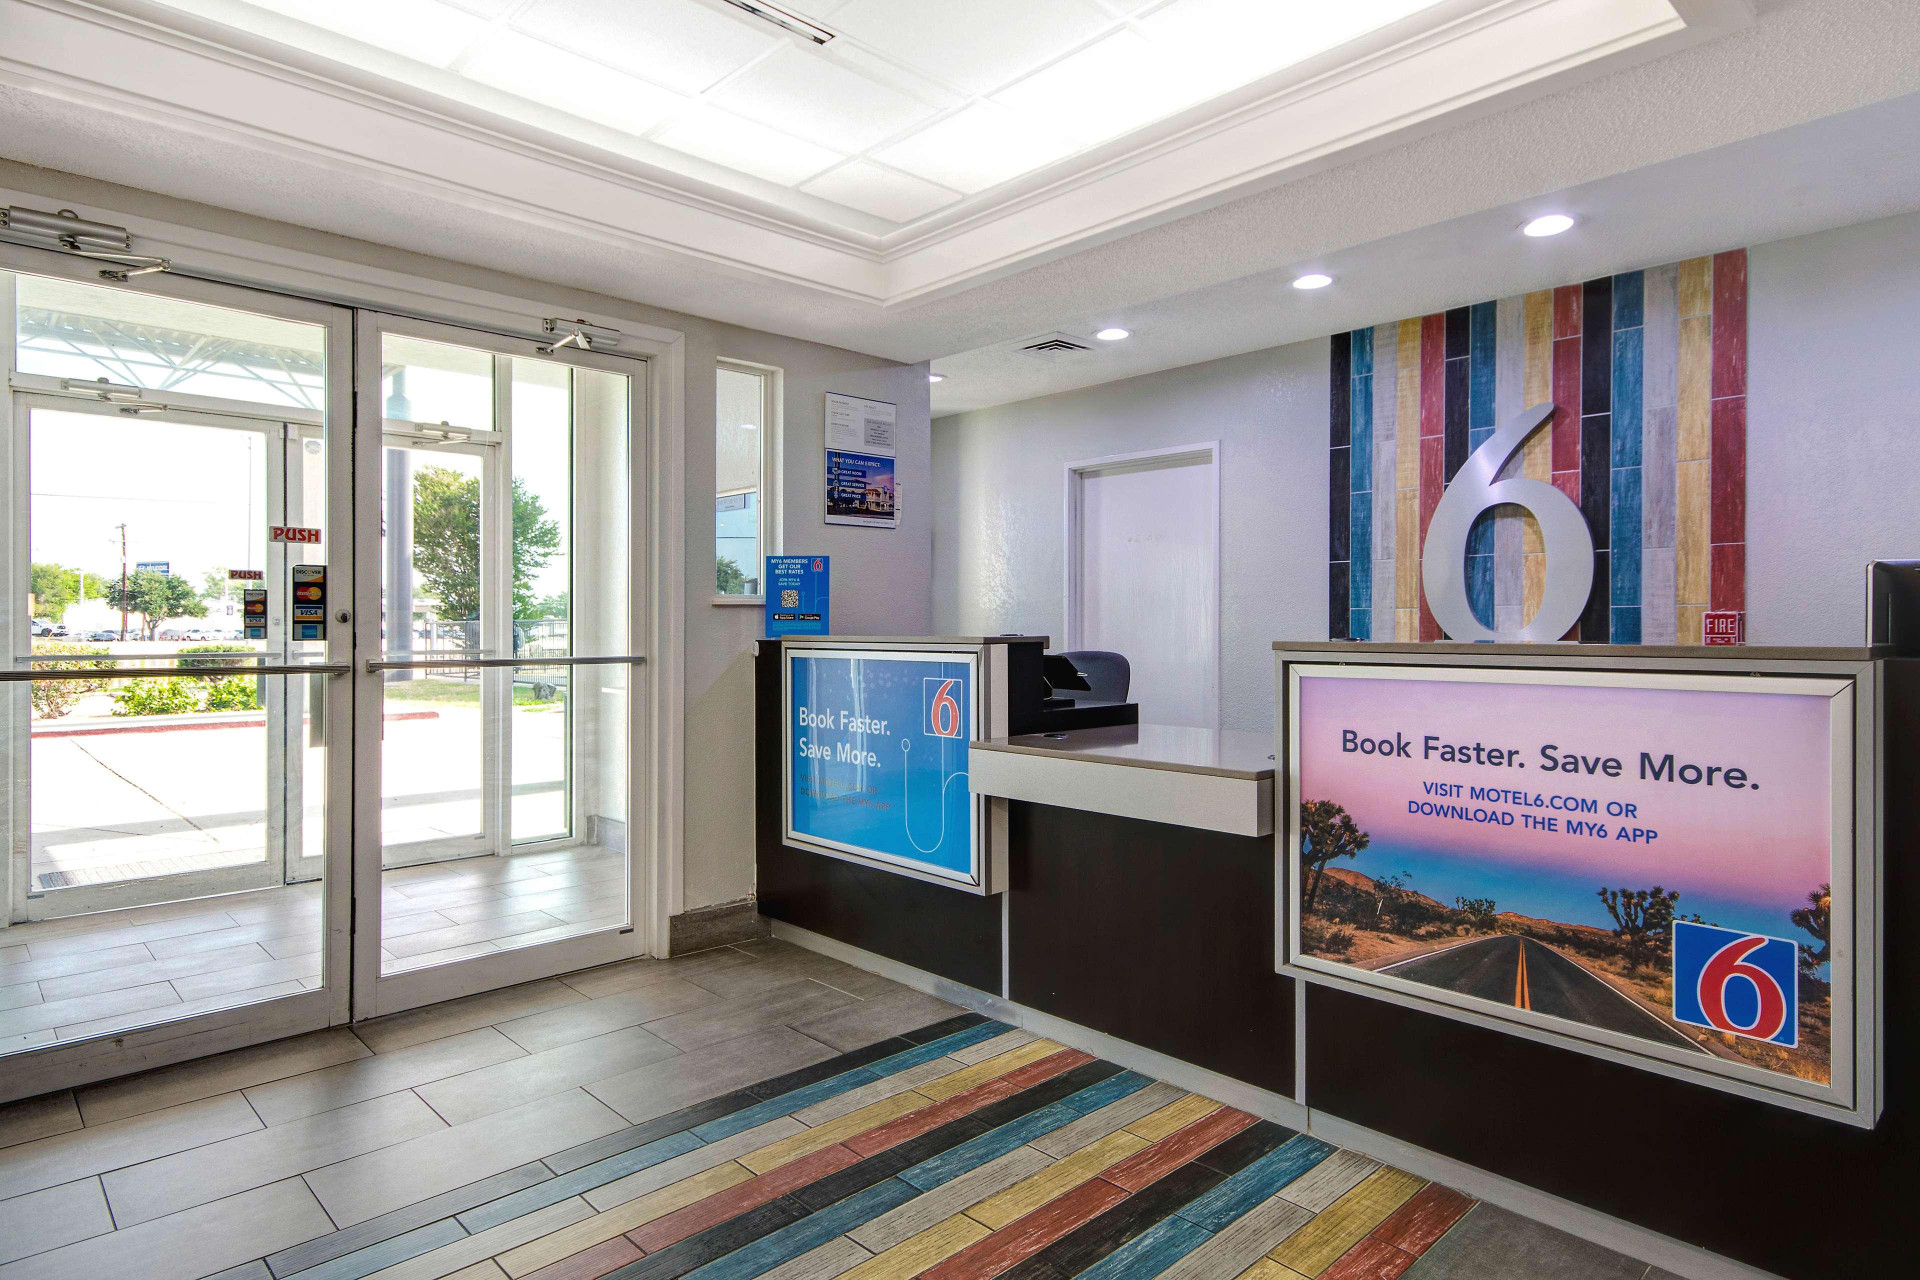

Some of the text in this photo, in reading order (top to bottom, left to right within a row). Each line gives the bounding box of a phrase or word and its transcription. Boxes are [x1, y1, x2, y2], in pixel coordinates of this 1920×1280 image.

[273, 527, 319, 543] PUSH
[1422, 402, 1595, 642] 6
[230, 570, 262, 580] PUSH
[814, 558, 823, 571] 6
[1706, 618, 1735, 633] FIRE
[799, 706, 891, 736] Book Faster.
[931, 679, 960, 737] 6
[799, 737, 881, 768] Save More.
[1341, 729, 1760, 791] Book Faster. Save More.
[842, 796, 855, 805] THE
[858, 798, 873, 808] MY6
[876, 801, 891, 811] APP
[867, 786, 878, 795] OR
[1423, 781, 1638, 819] VISIT MOTEL6.COM OR
[1408, 800, 1658, 845] DOWNLOAD THE MY6 APP
[1698, 936, 1787, 1041] 6
